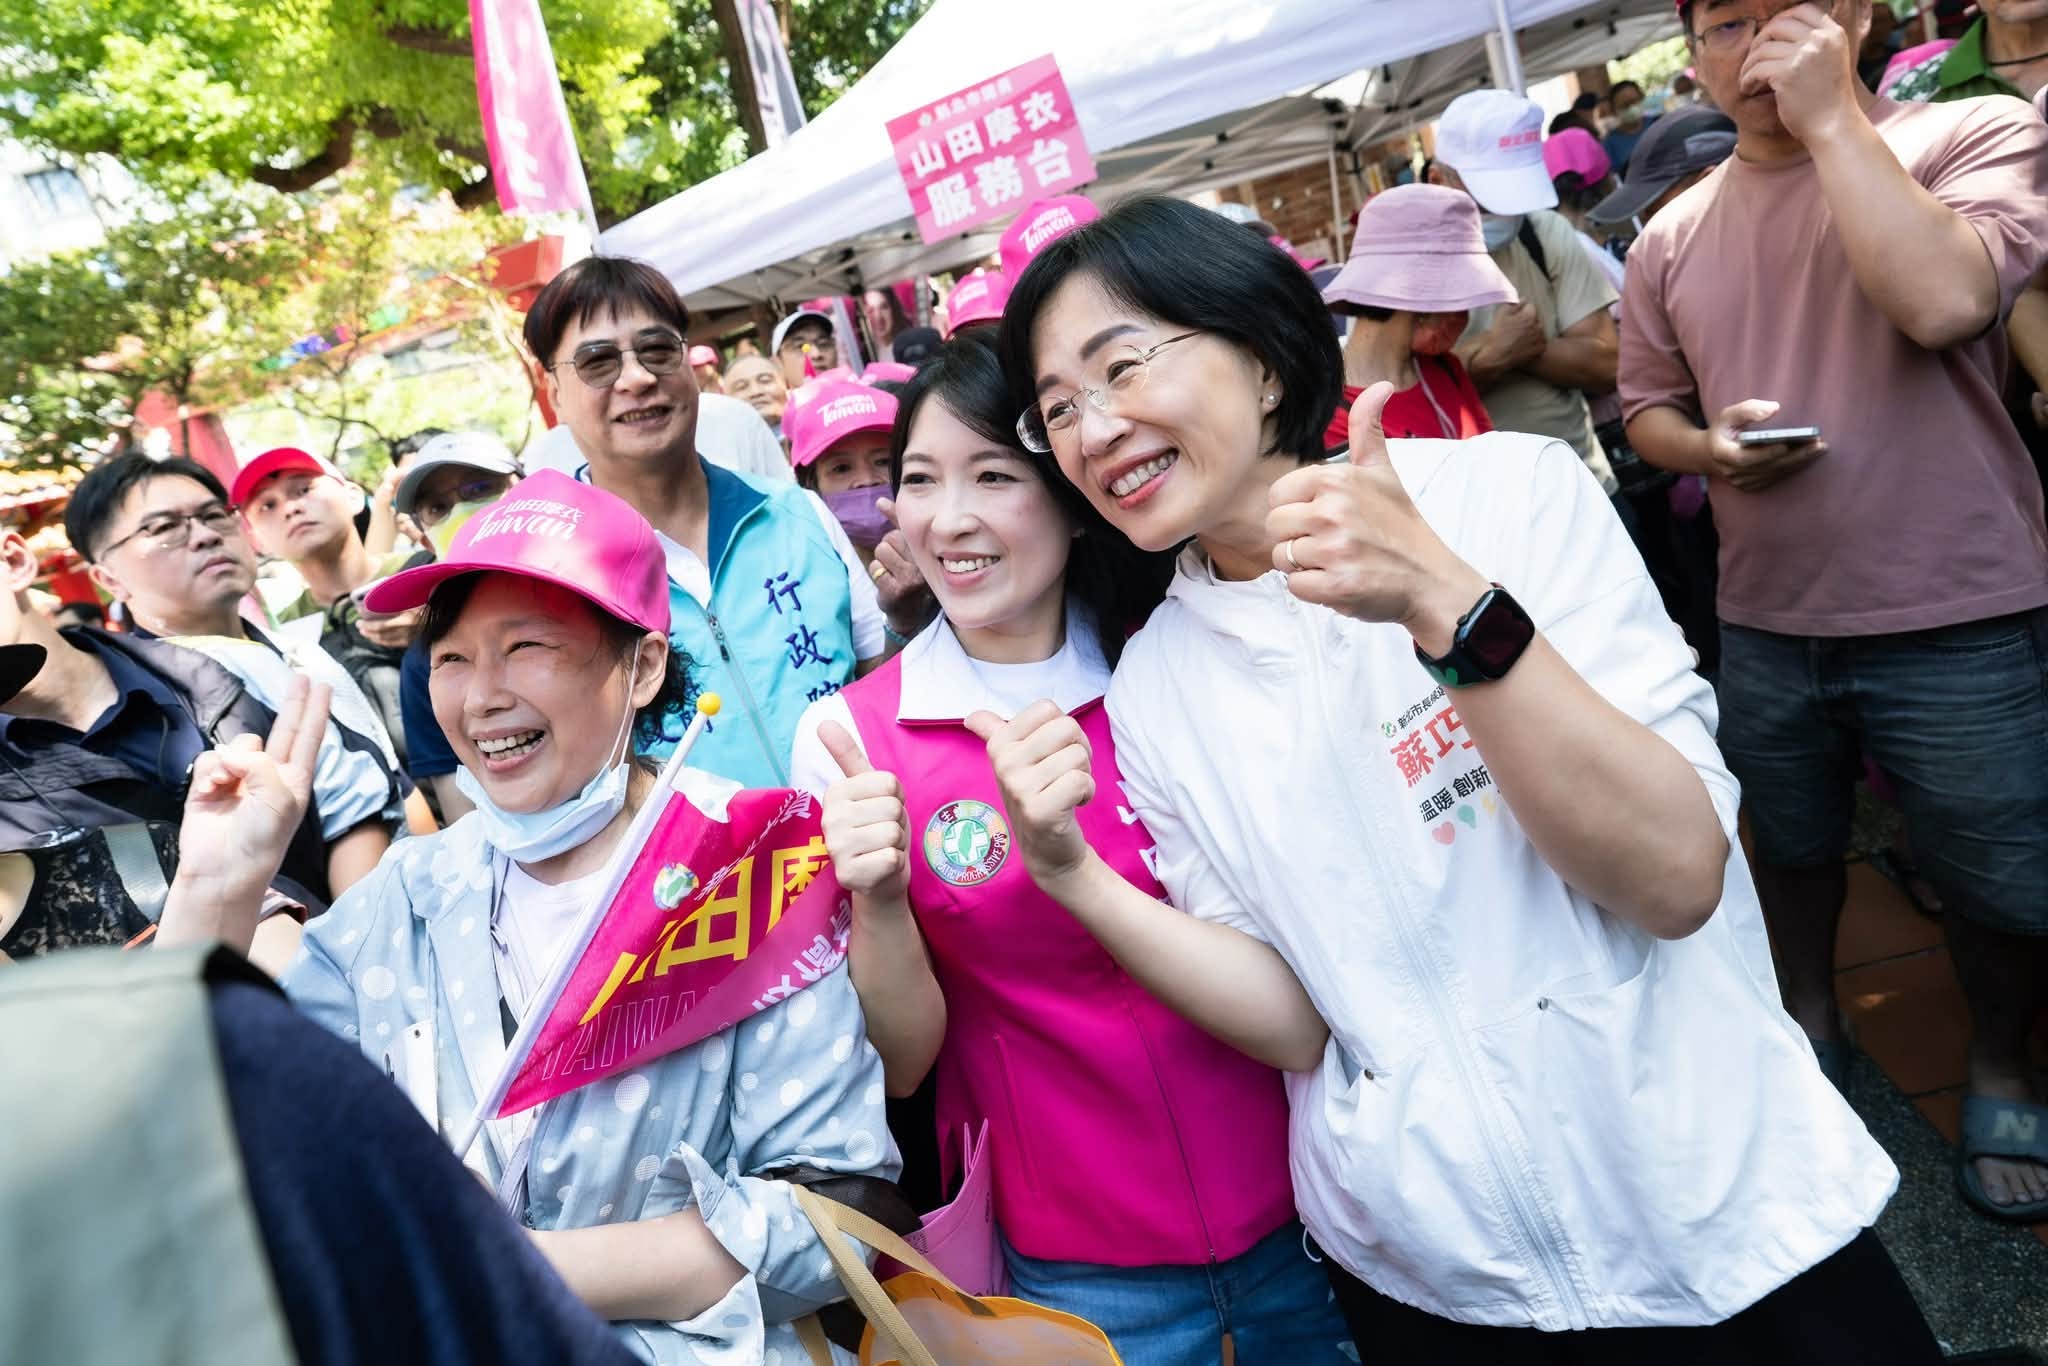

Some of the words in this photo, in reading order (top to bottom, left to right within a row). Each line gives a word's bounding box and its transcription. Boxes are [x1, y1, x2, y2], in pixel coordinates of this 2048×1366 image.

[925, 138, 1072, 228] 服務台
[468, 503, 577, 547] Taiwan
